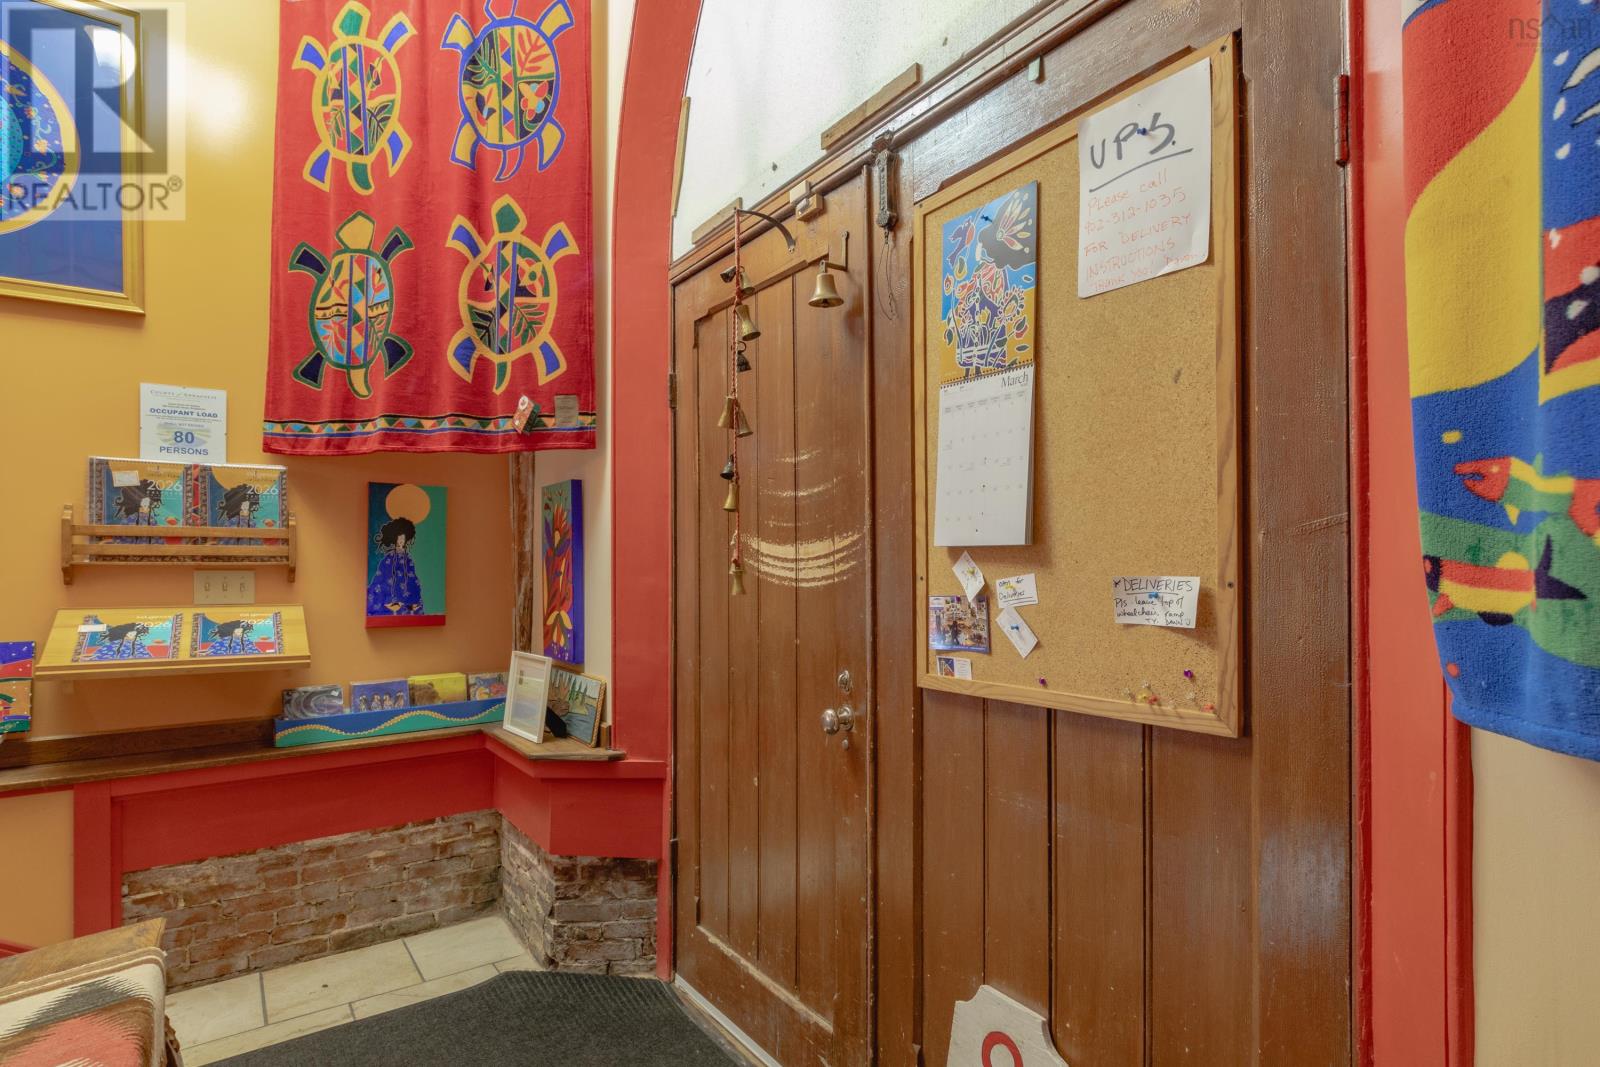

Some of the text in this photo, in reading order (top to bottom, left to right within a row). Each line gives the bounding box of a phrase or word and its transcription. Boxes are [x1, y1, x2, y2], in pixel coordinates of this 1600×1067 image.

[1118, 214, 1193, 244] DELIVERY
[1001, 371, 1029, 388] March
[149, 407, 195, 416] OCCUPANT
[196, 411, 218, 419] LOAD
[174, 430, 195, 444] 80
[159, 446, 209, 456] PERSONS
[147, 479, 183, 491] 2026
[1122, 577, 1193, 592] DELIVERIES
